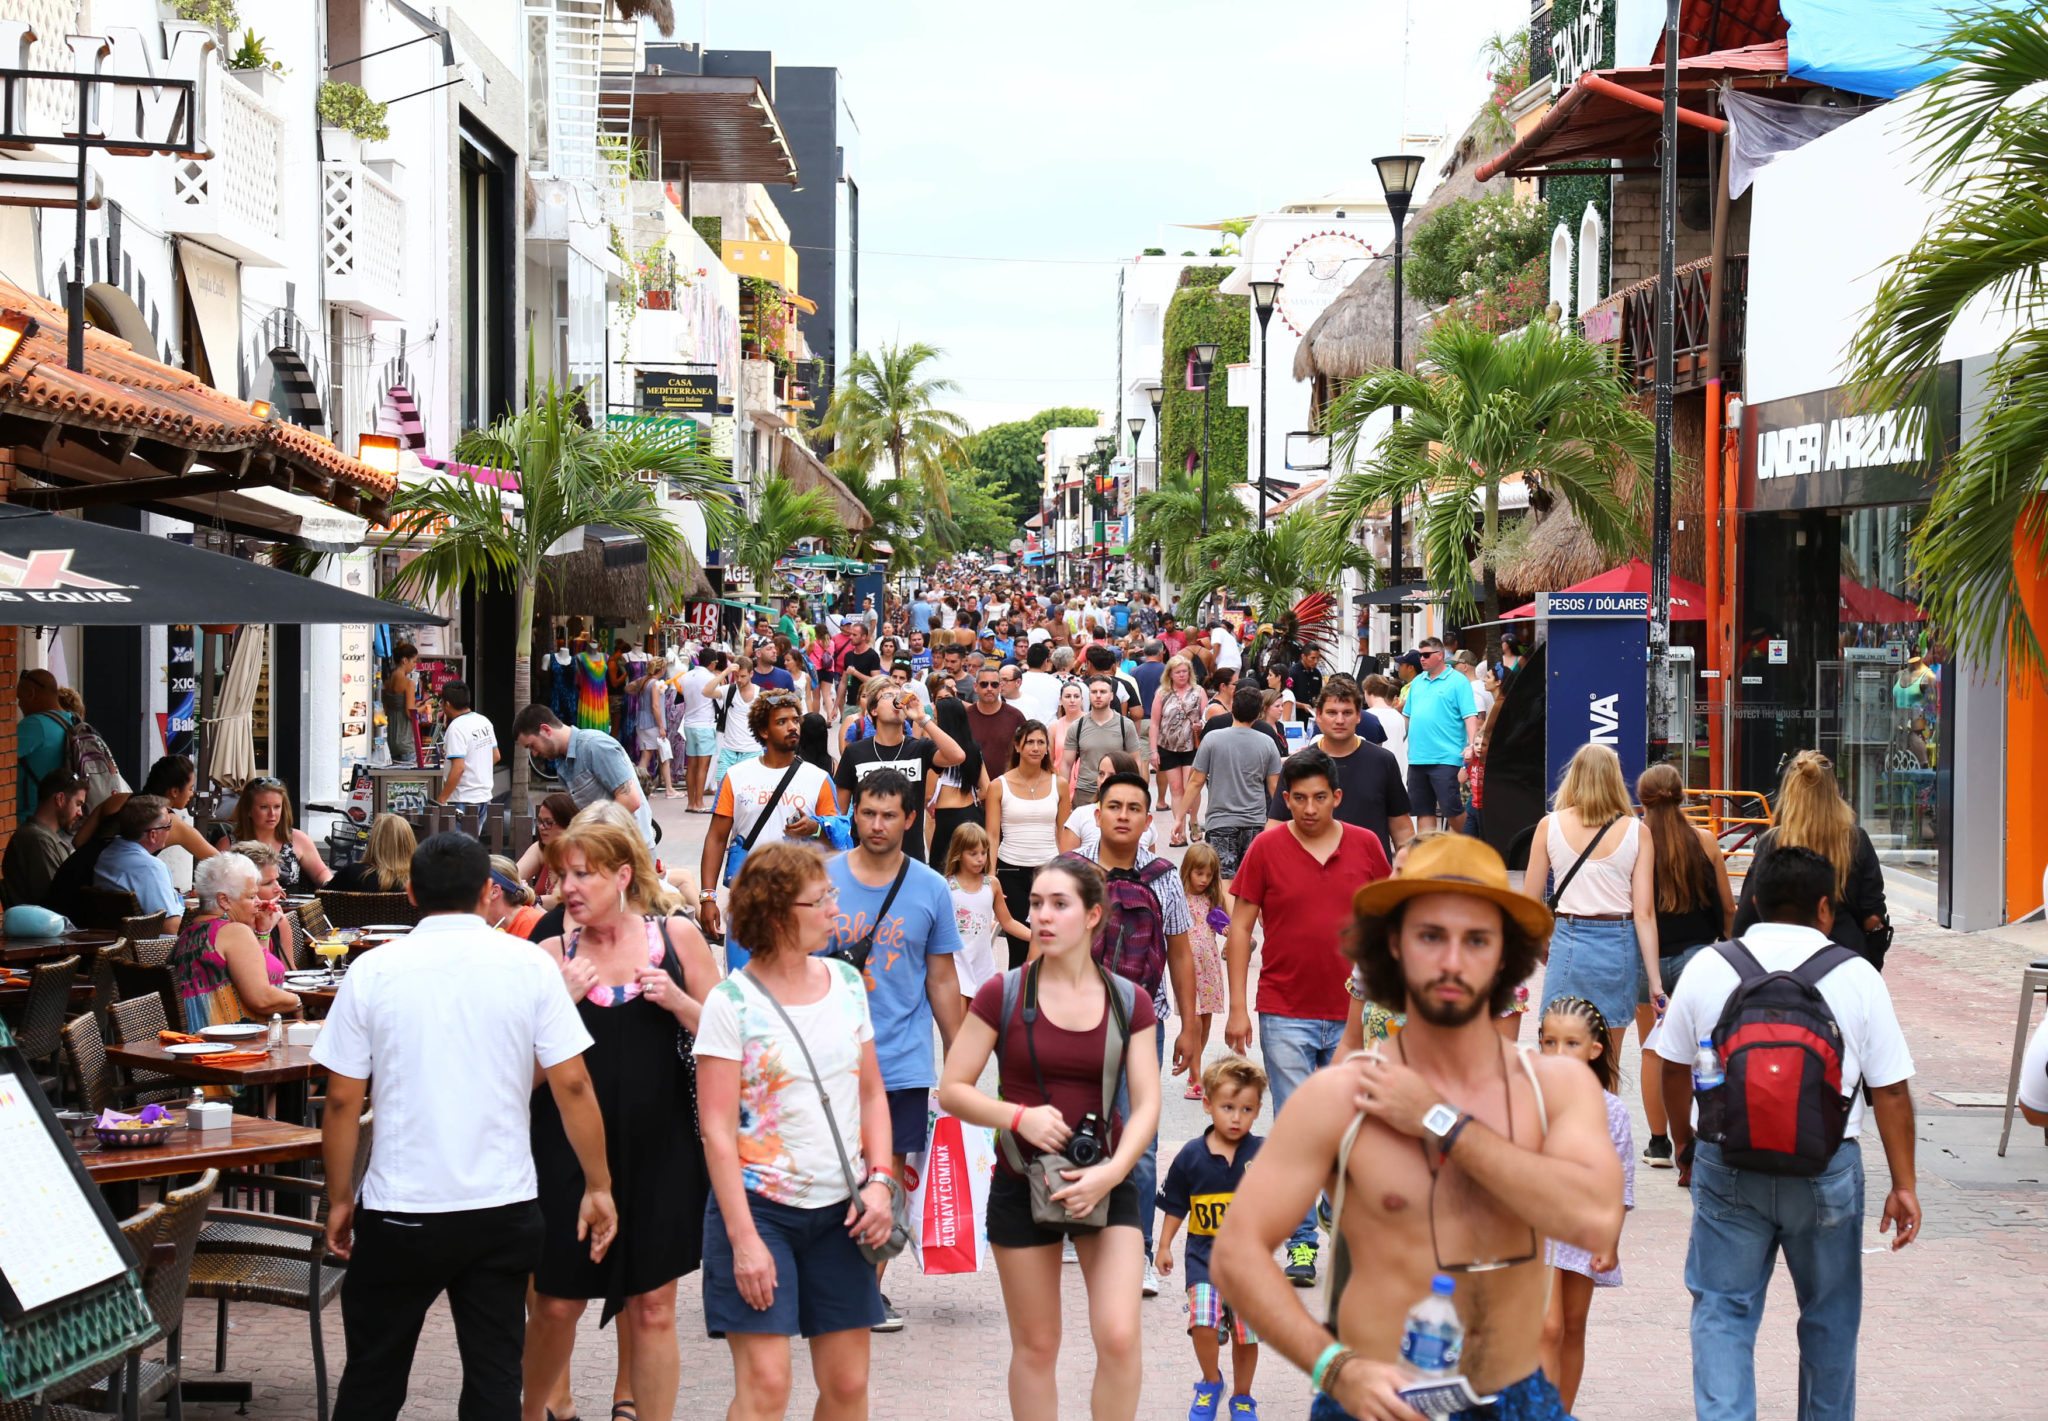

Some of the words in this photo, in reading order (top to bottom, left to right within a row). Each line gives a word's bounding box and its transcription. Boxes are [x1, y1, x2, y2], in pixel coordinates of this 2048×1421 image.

[646, 386, 714, 396] MEDITERRANEA
[668, 378, 693, 387] CASA
[1757, 422, 1823, 481] UNDER
[25, 591, 132, 603] EQUIS
[1548, 599, 1585, 611] PESOS
[1596, 596, 1648, 611] DÓLARES
[342, 653, 366, 661] Gadget
[1589, 693, 1619, 744] IVA
[758, 790, 806, 809] BVO
[936, 1145, 956, 1248] OLDNAVY.COM/MX
[1194, 1202, 1230, 1229] BB
